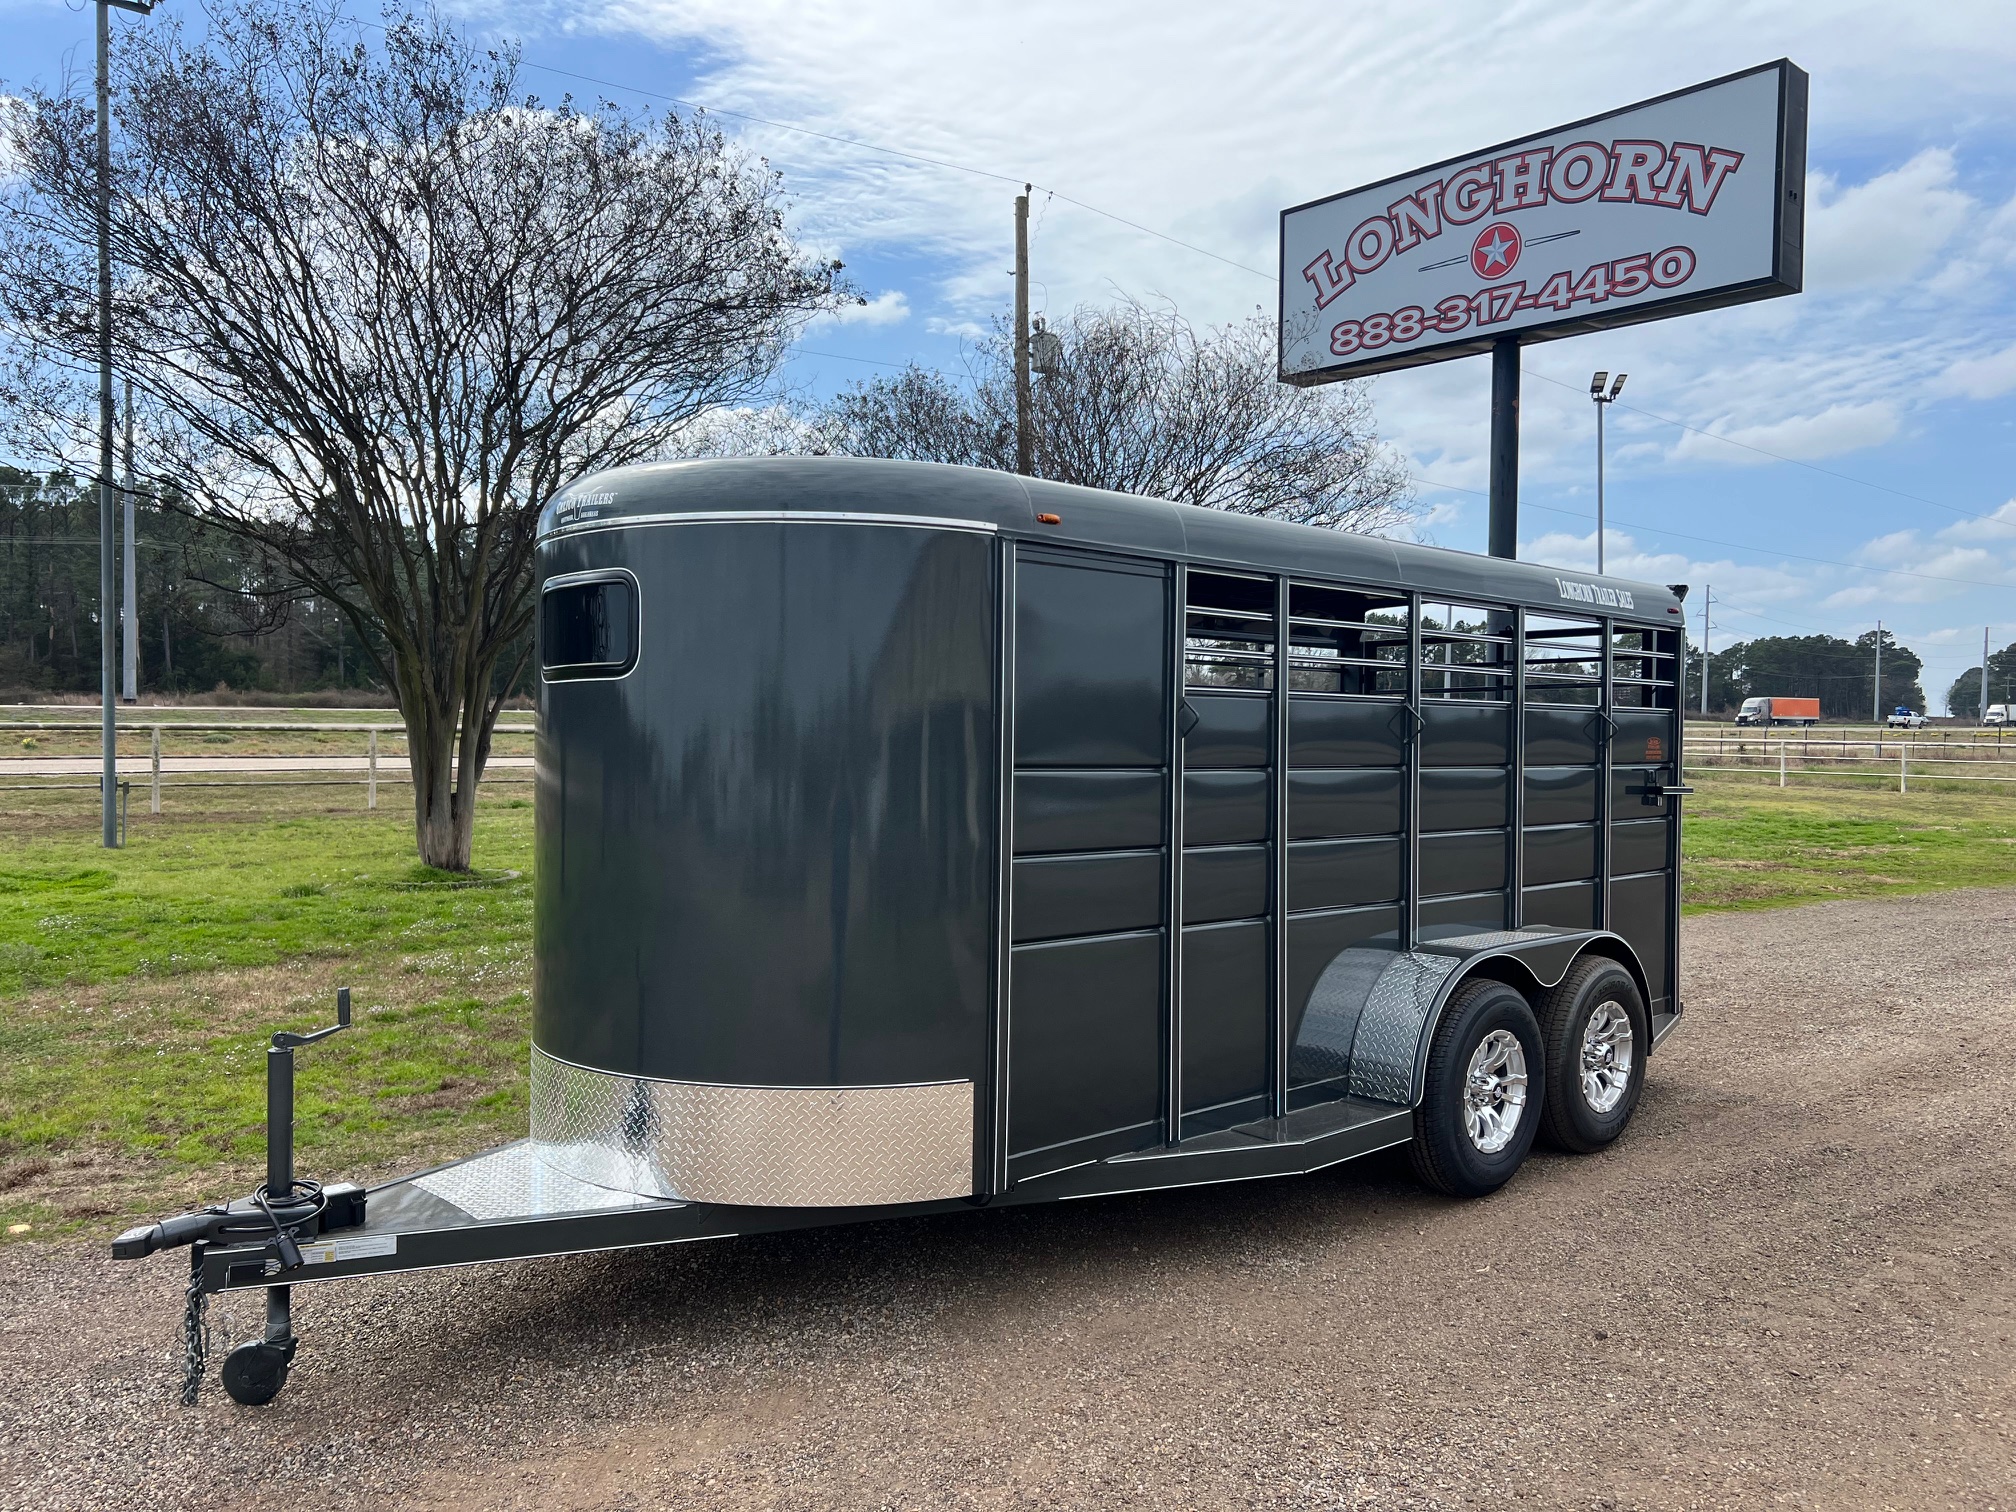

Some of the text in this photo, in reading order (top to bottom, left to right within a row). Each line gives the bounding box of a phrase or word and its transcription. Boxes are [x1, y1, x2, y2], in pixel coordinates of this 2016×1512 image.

[1302, 139, 1745, 310] LONGHORN
[1329, 245, 1697, 356] 888-317-4450
[577, 492, 614, 507] TRAILERS
[1555, 578, 1634, 609] LONGHORN TRAILER SALES
